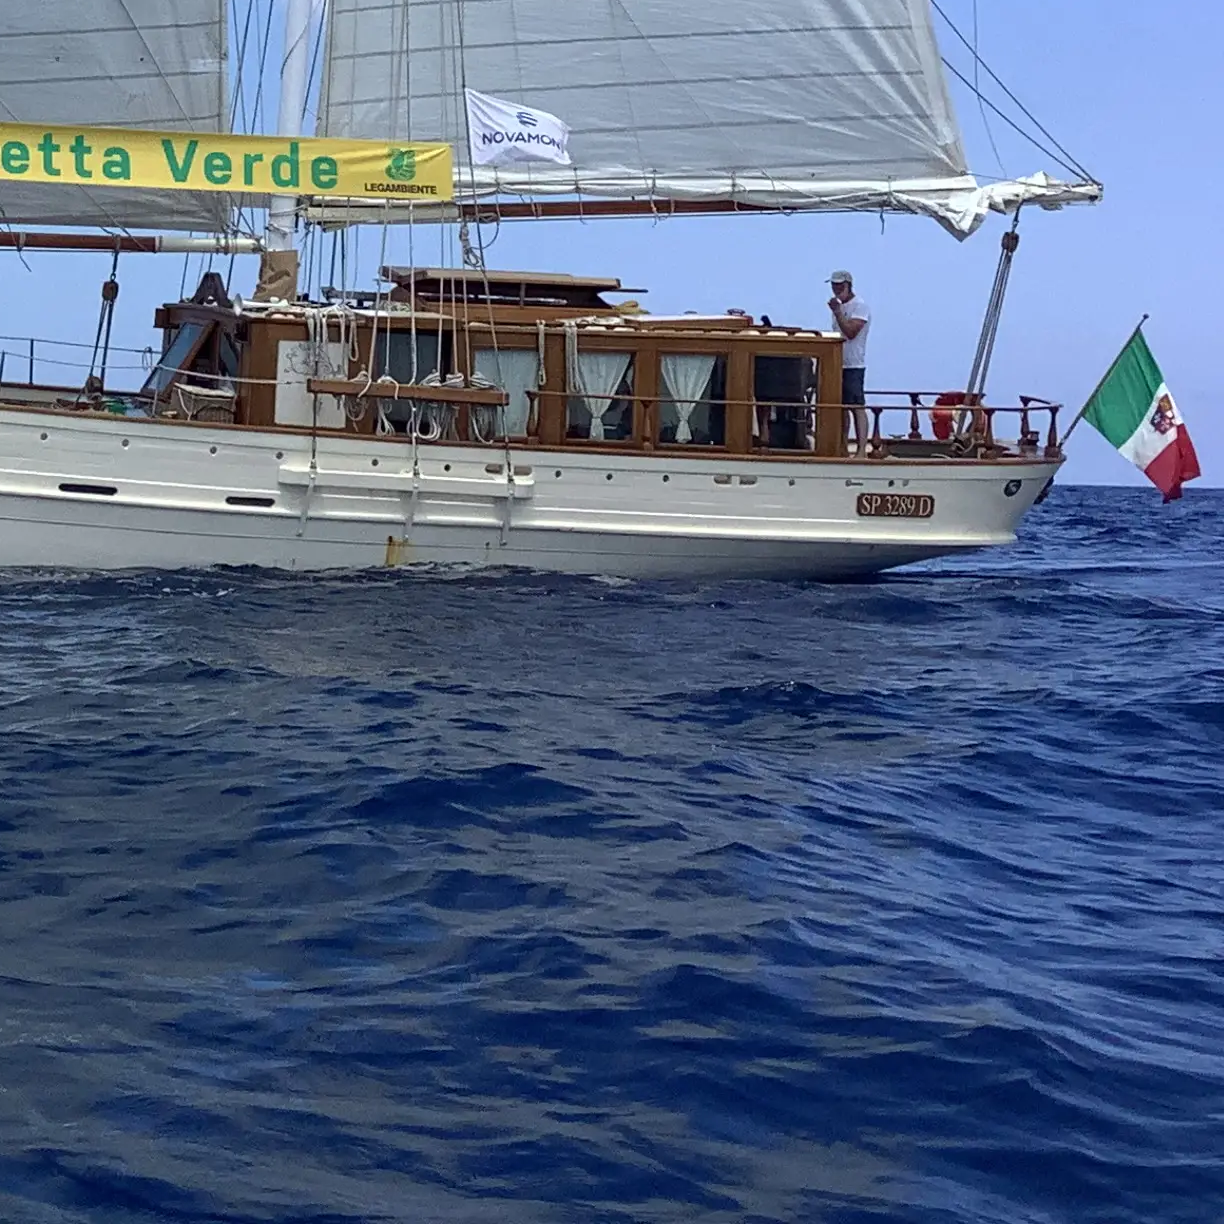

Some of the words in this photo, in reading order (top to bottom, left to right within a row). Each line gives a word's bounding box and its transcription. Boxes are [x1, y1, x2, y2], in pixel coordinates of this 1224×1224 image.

[161, 139, 338, 190] Verde
[364, 182, 438, 196] LEGAMBIENTE
[861, 494, 881, 515] SP
[884, 495, 915, 516] 3289
[919, 496, 931, 516] D
